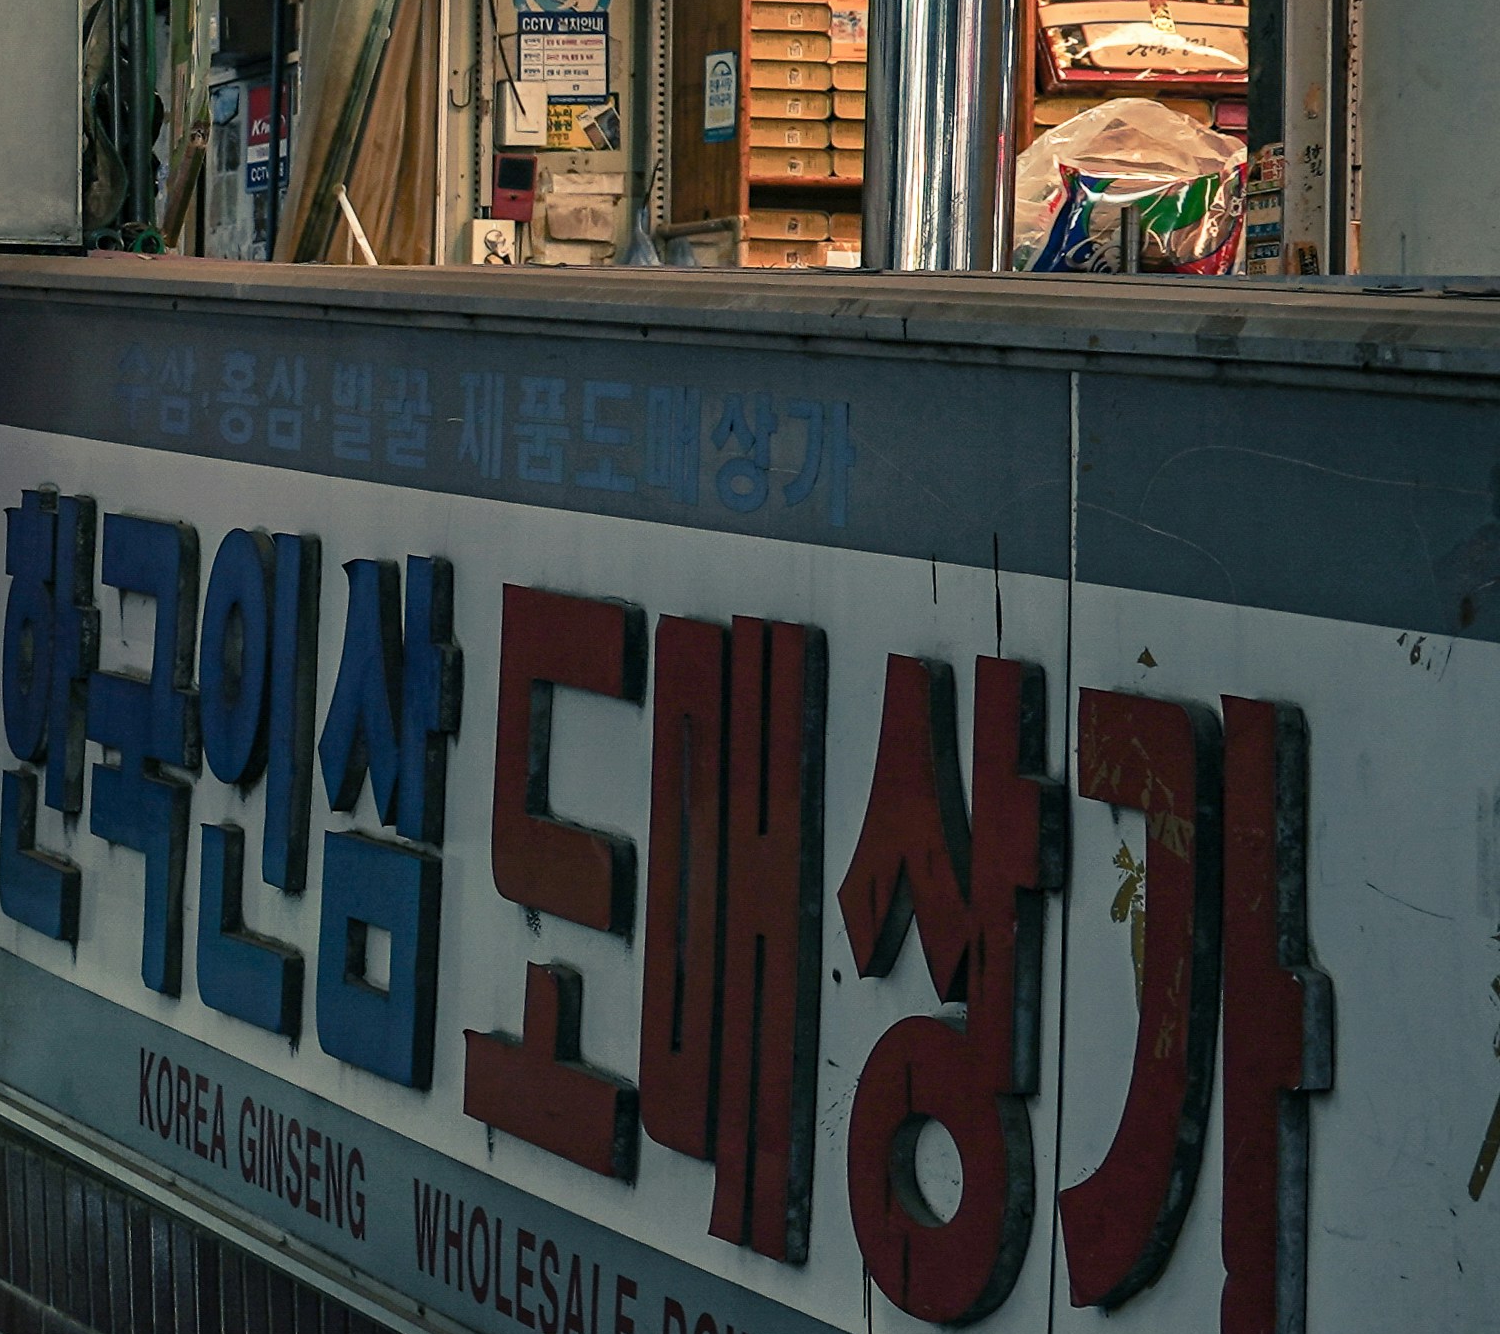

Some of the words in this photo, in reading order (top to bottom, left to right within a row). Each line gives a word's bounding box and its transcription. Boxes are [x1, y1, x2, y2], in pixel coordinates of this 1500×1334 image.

[522, 17, 554, 31] CCTV
[557, 16, 604, 32] 설치안내
[456, 369, 857, 529] 제품도매상가
[137, 1047, 227, 1155] KOREA
[237, 1092, 368, 1243] GINSENG
